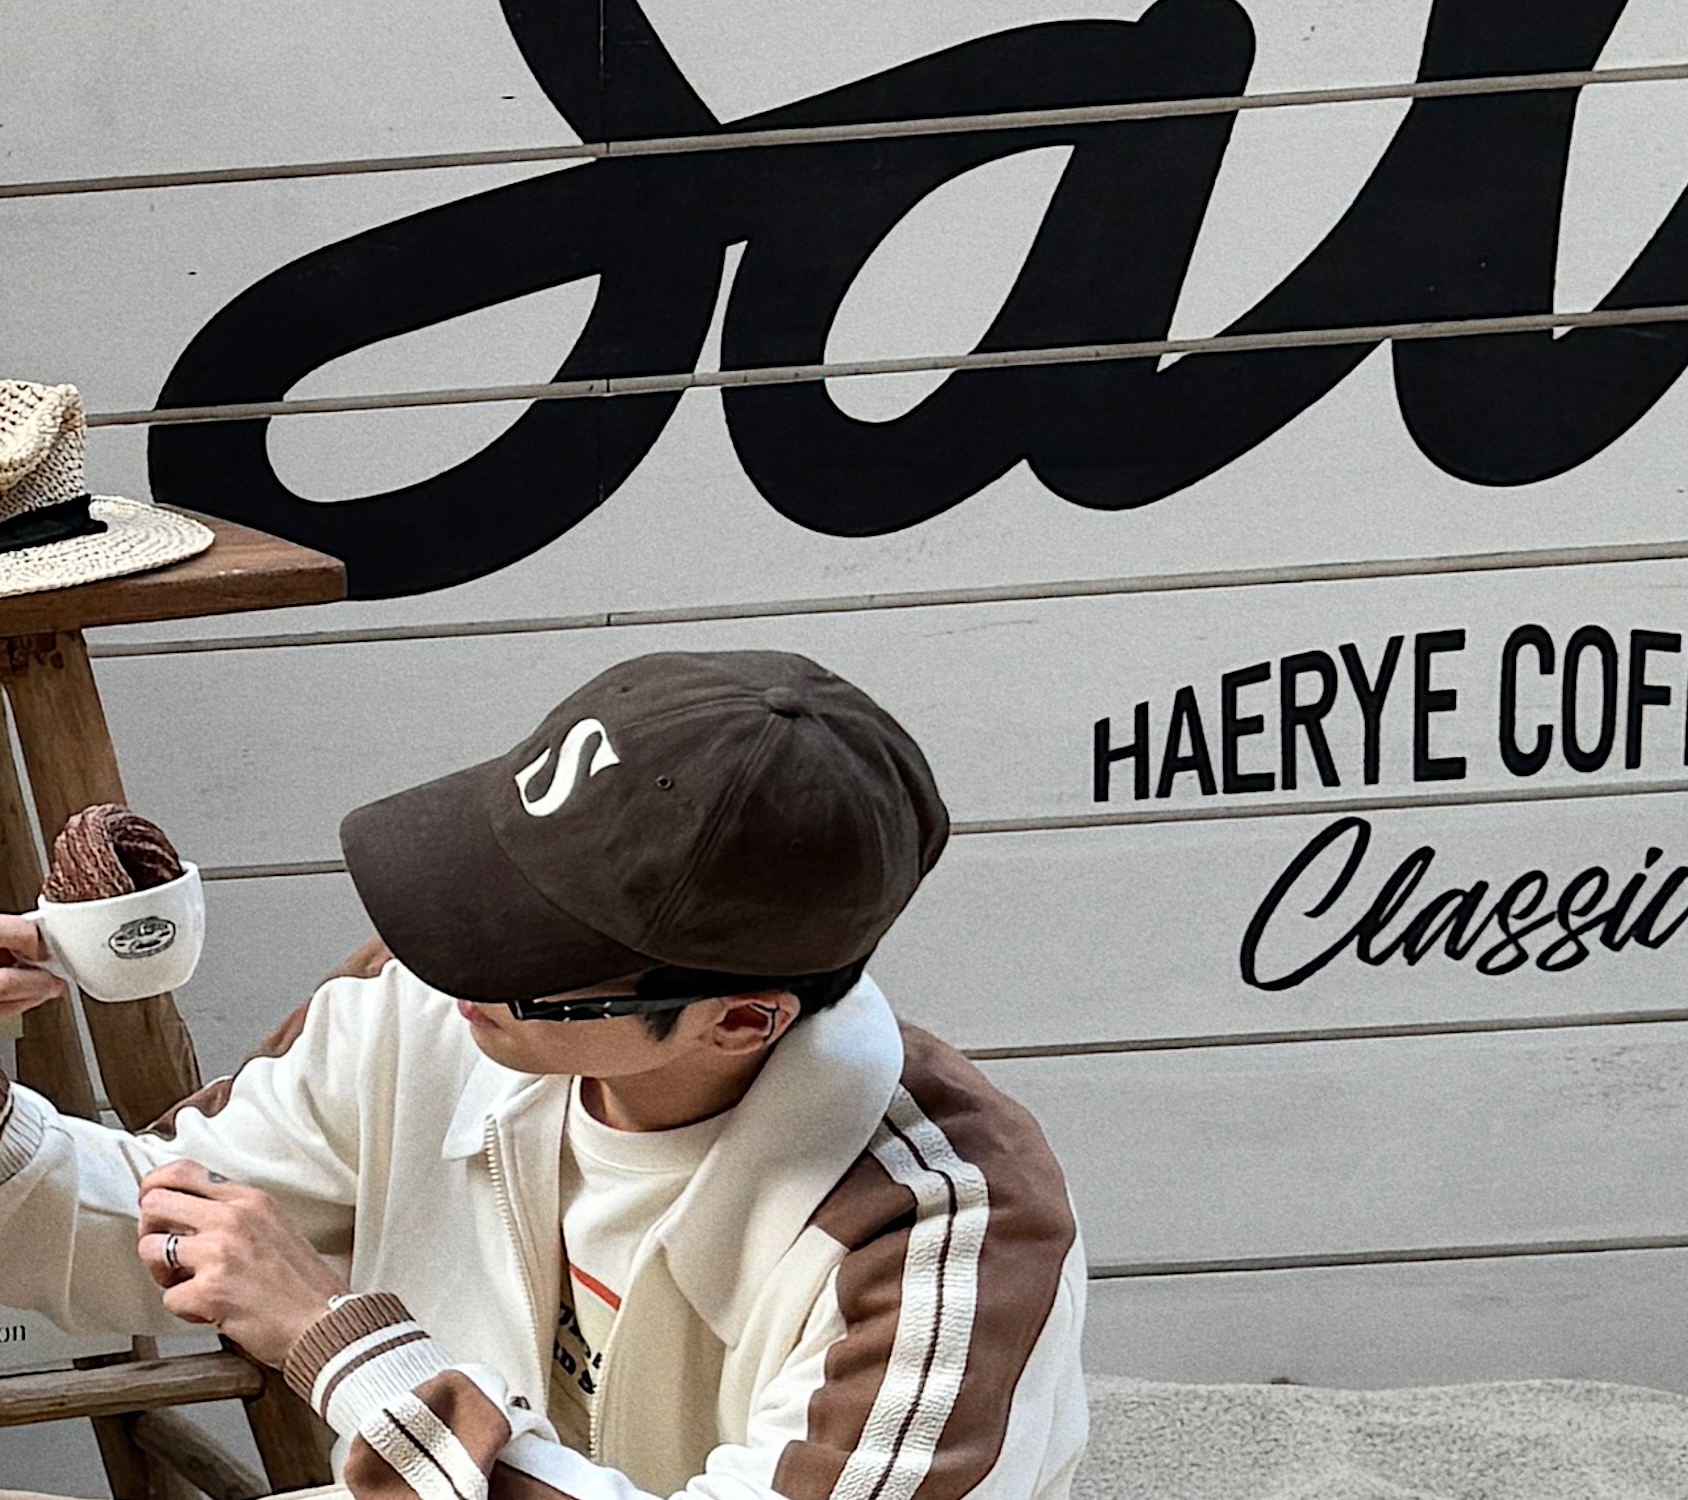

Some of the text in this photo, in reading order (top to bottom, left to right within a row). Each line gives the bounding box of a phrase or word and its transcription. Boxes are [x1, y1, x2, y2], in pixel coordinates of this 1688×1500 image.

[514, 718, 620, 818] S
[1093, 624, 1688, 802] HAERYE COF
[1240, 816, 1688, 991] Classic
